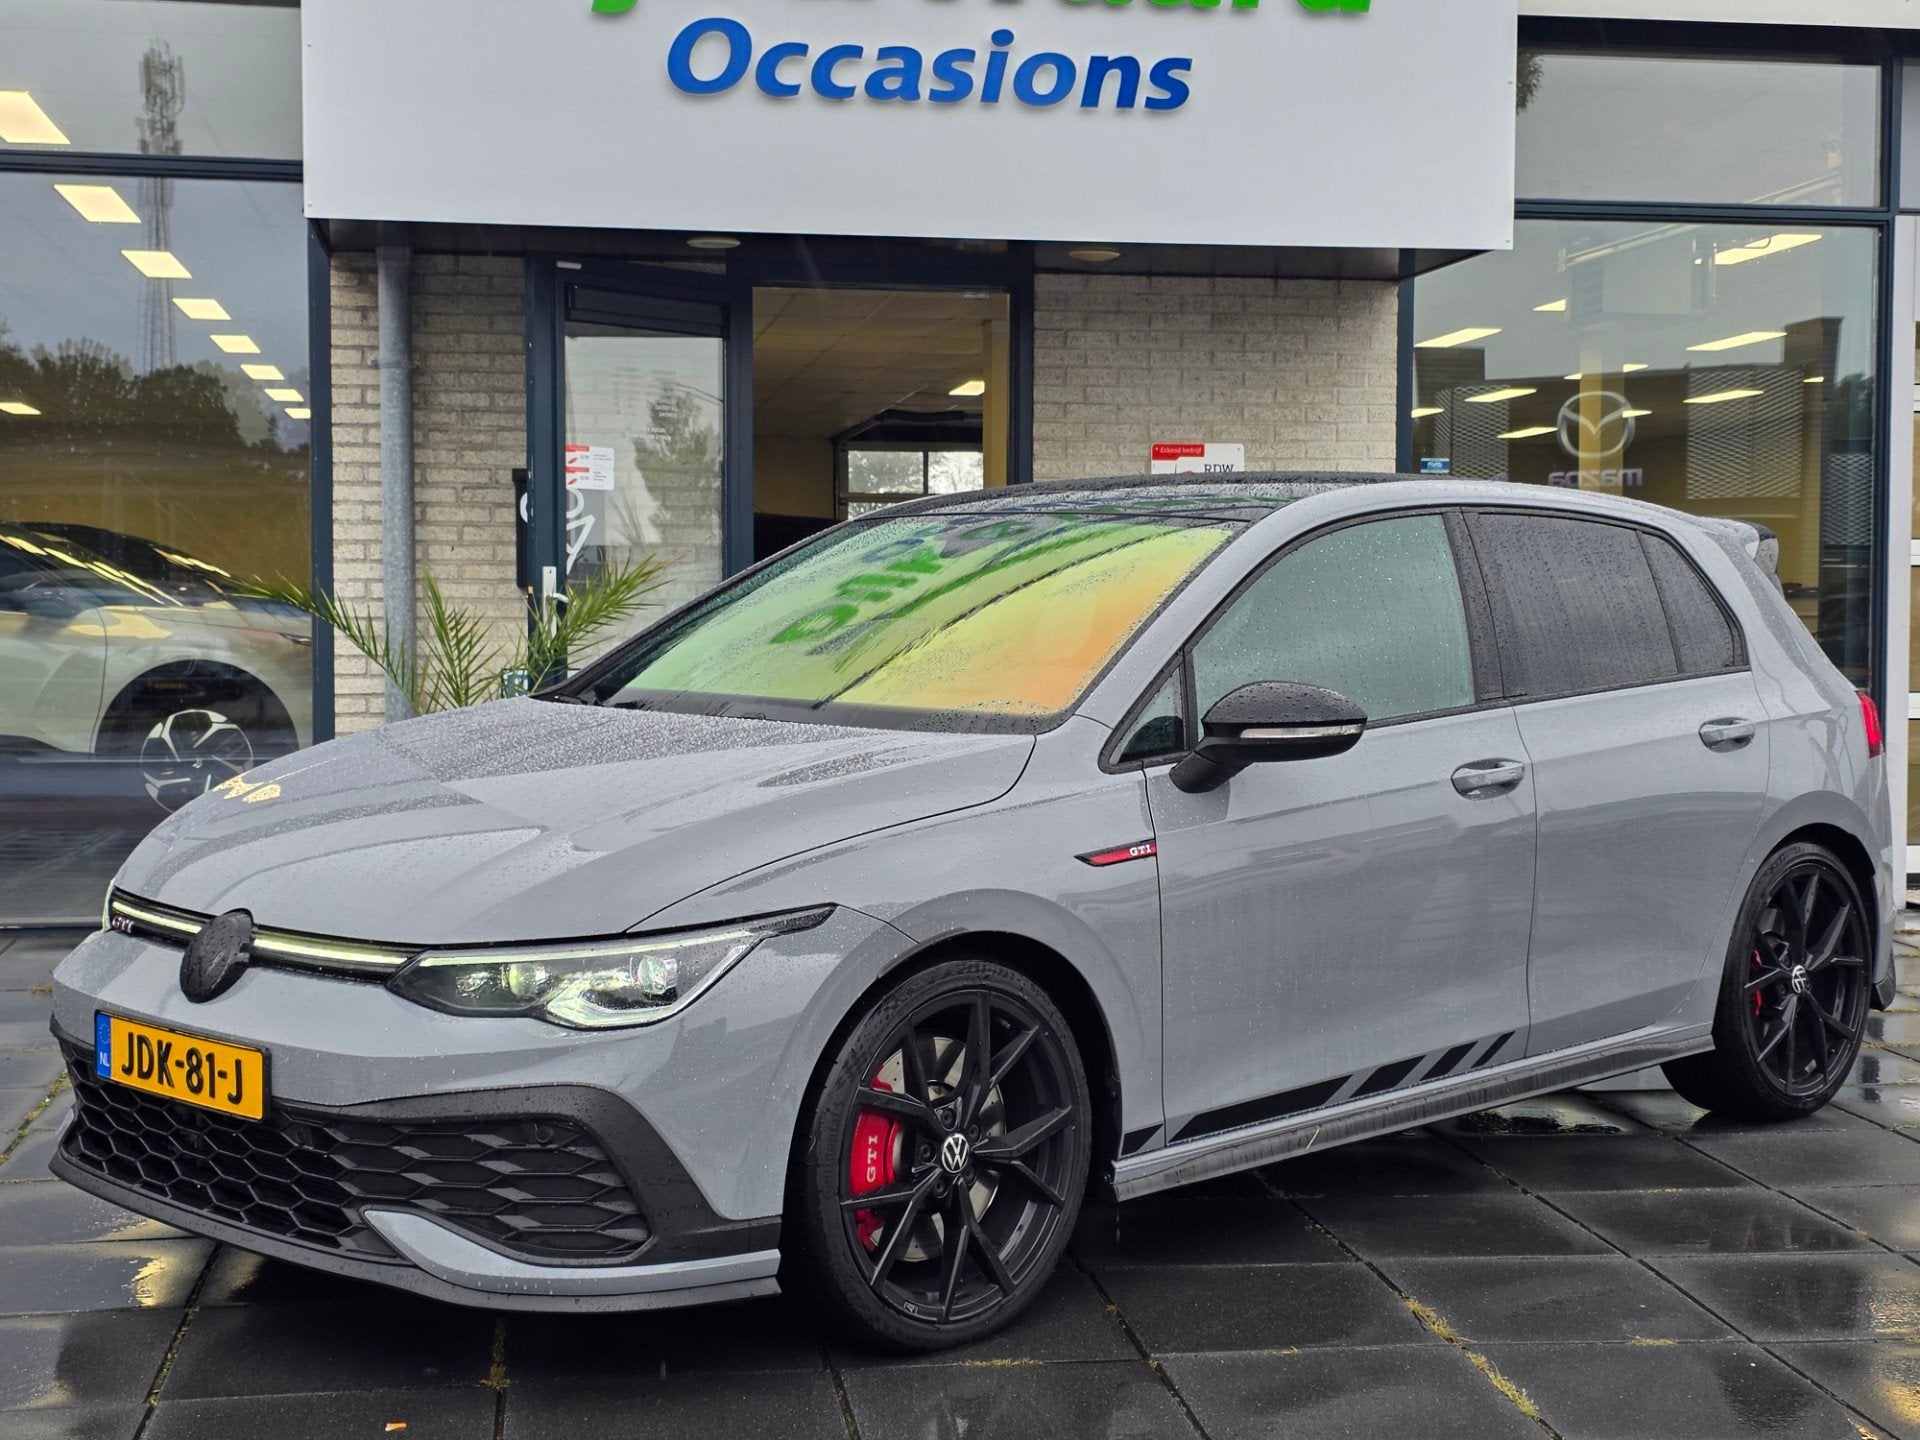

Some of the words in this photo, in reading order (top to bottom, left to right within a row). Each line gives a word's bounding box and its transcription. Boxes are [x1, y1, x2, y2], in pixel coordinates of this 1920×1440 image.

[667, 17, 1192, 111] Occasions
[1129, 844, 1152, 856] GTI
[99, 1052, 111, 1068] NL
[121, 1031, 243, 1105] JDK-81-J
[865, 1133, 879, 1184] GTI
